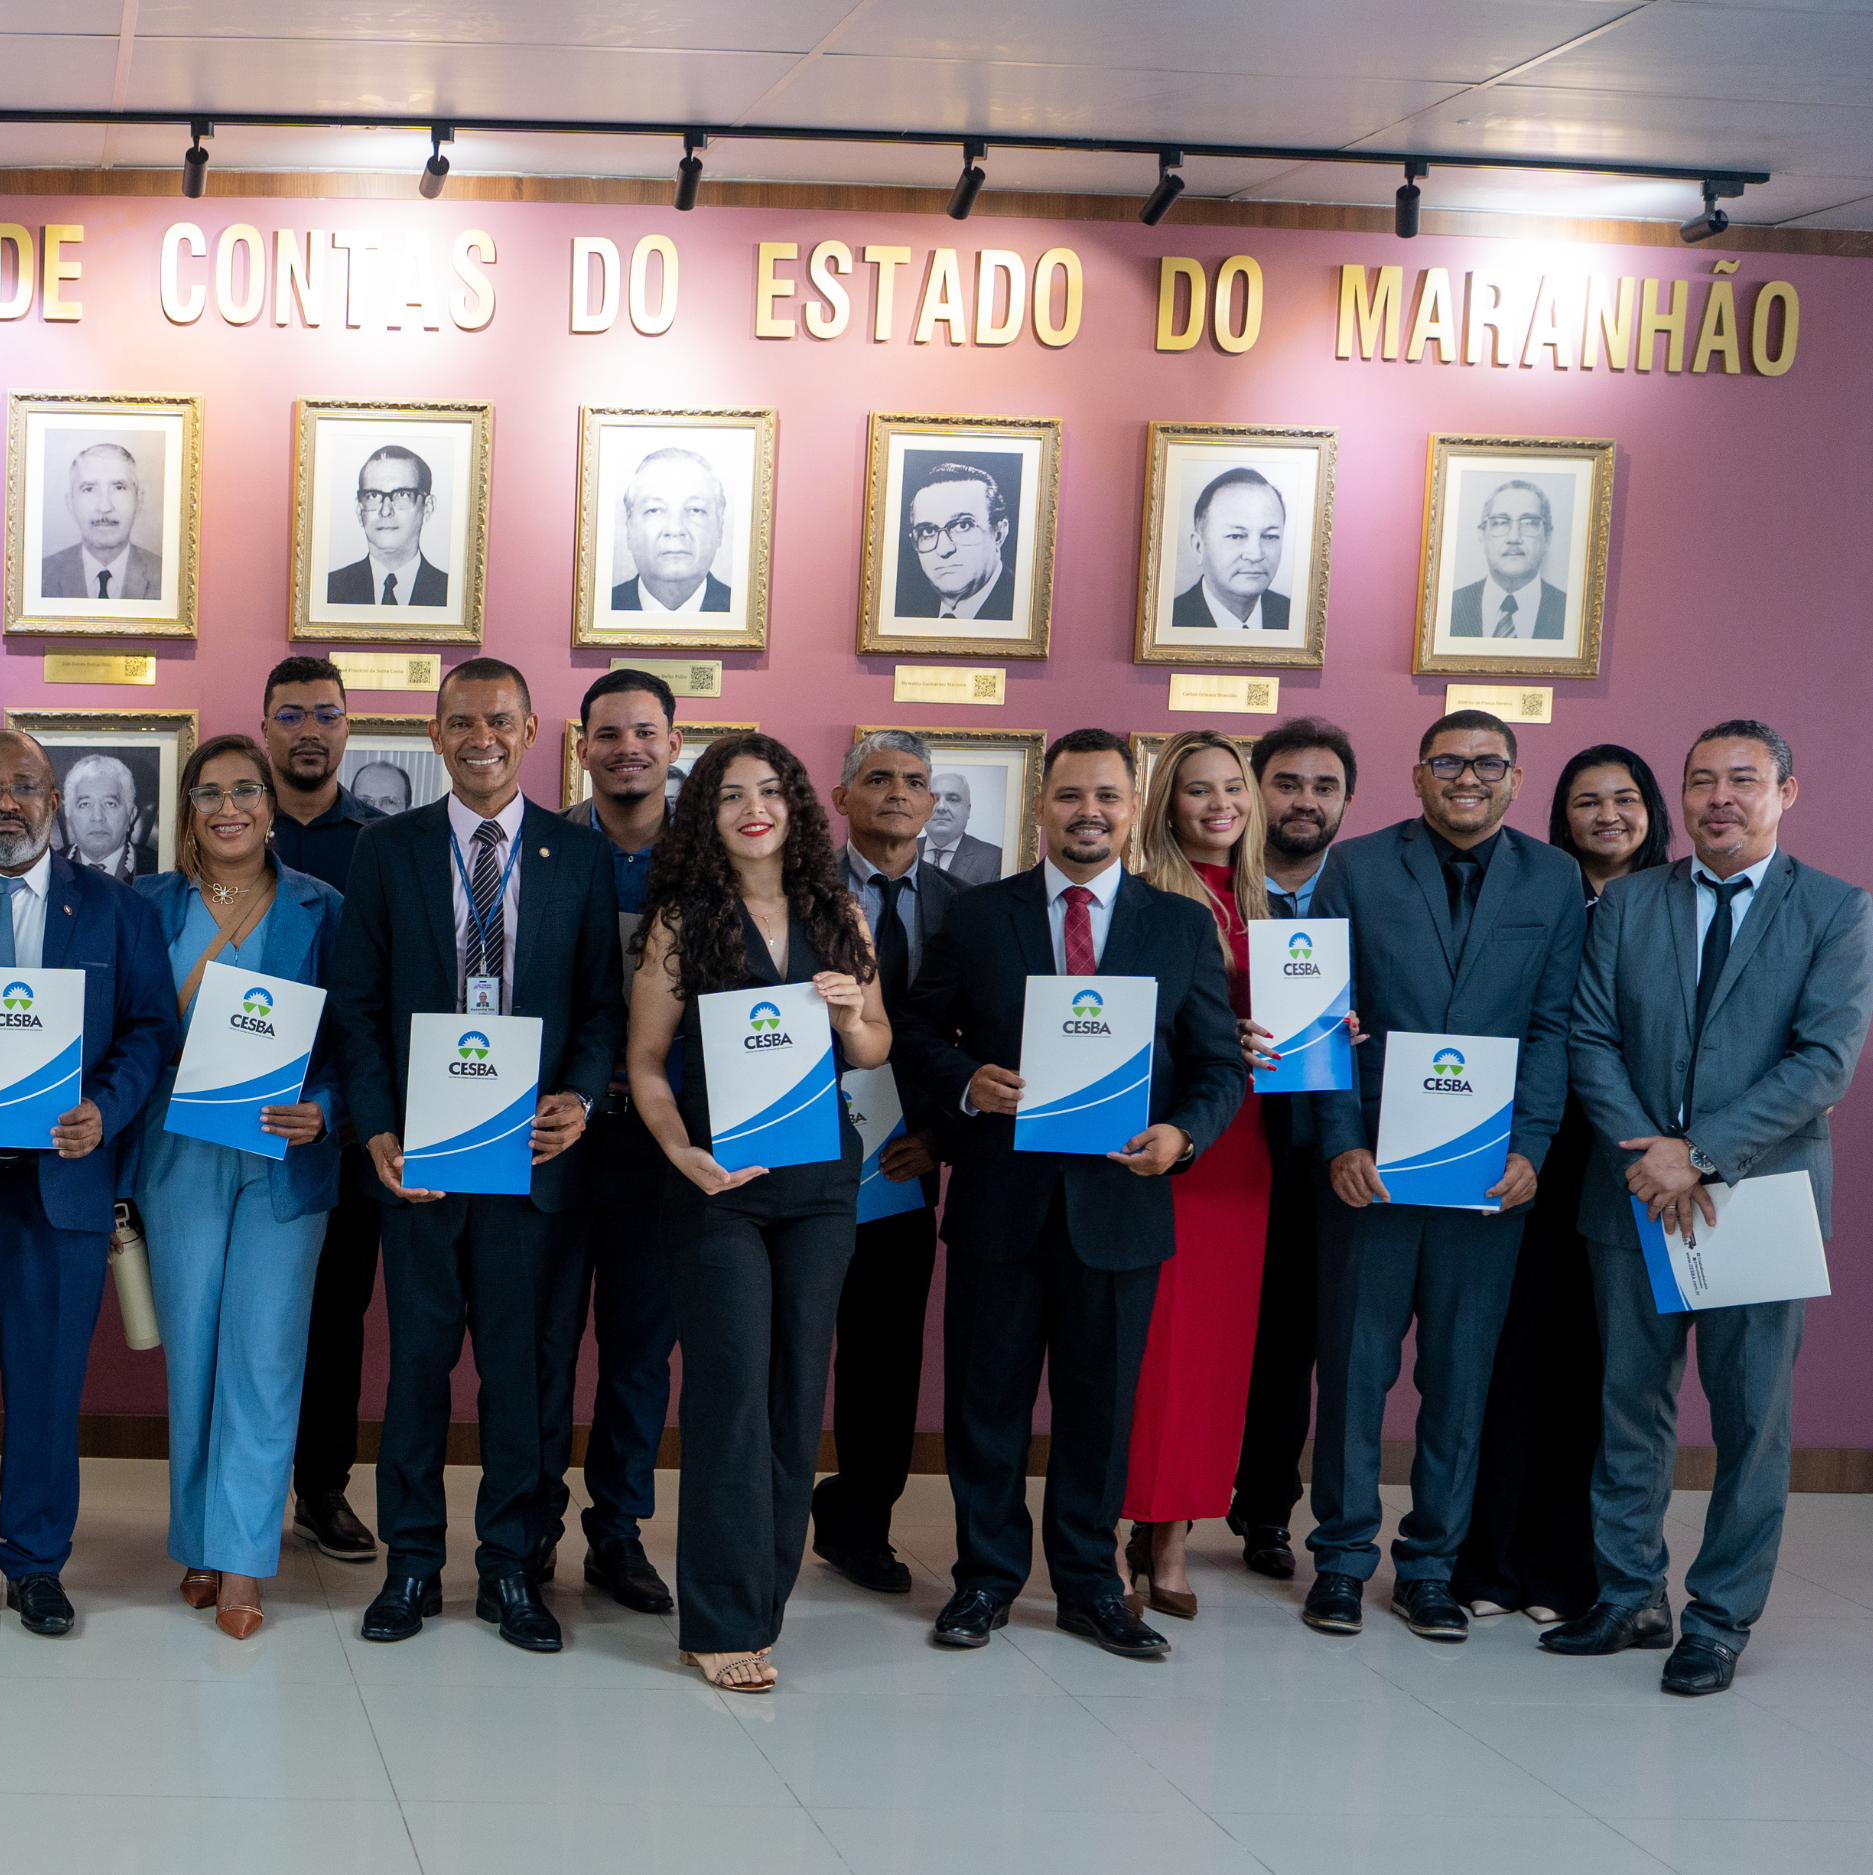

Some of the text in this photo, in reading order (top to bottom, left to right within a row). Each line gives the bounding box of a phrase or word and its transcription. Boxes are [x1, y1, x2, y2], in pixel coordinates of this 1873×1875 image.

[160, 221, 498, 332] CONTAS
[569, 234, 680, 336] DO
[755, 240, 1084, 347] ESTADO
[1155, 254, 1264, 354] DO
[1335, 259, 1800, 377] MARANHÃO
[1283, 963, 1321, 976] CESBA
[230, 1014, 275, 1037] CESBA
[1062, 1020, 1112, 1034] CESBA
[743, 1032, 793, 1050] CESBA
[448, 1062, 498, 1076] CESBA
[1423, 1077, 1473, 1093] CESBA
